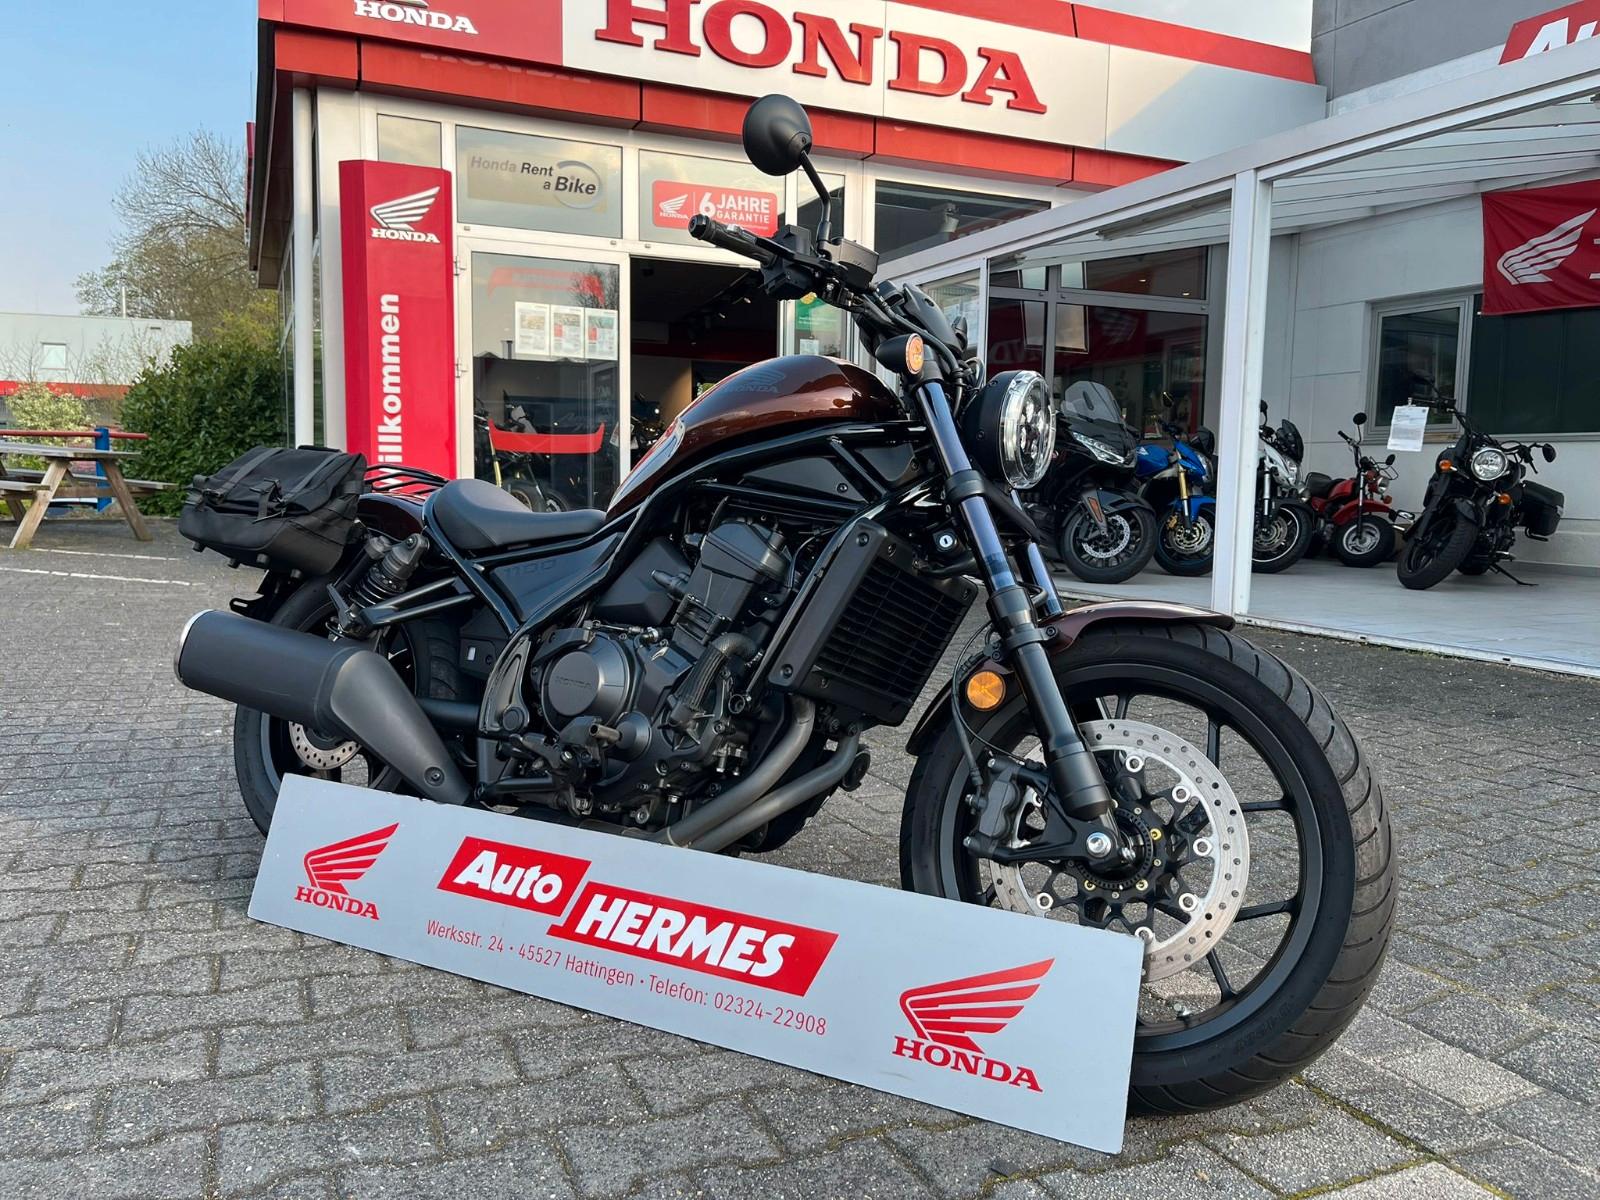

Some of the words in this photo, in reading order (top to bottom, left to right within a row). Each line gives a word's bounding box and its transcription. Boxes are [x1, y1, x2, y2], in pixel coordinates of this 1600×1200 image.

[354, 0, 479, 35] HONDA
[594, 0, 1048, 115] HONDA
[470, 155, 517, 173] Honda
[520, 162, 554, 177] Rent
[543, 181, 551, 190] a
[554, 175, 597, 196] Bike
[699, 191, 716, 218] 6
[716, 193, 770, 214] JAHRE
[715, 210, 770, 224] GARANTIE
[371, 227, 441, 243] HONDA
[294, 885, 381, 921] HONDA
[454, 850, 563, 904] Auto
[575, 893, 794, 977] HERMES
[427, 919, 483, 949] Werksstr.
[487, 934, 504, 953] 24
[518, 943, 562, 968] 45527
[565, 953, 635, 986] Hattingen
[649, 974, 709, 1006] Telefon:
[714, 991, 827, 1036] 02324-22908
[892, 1035, 1044, 1093] HONDA
